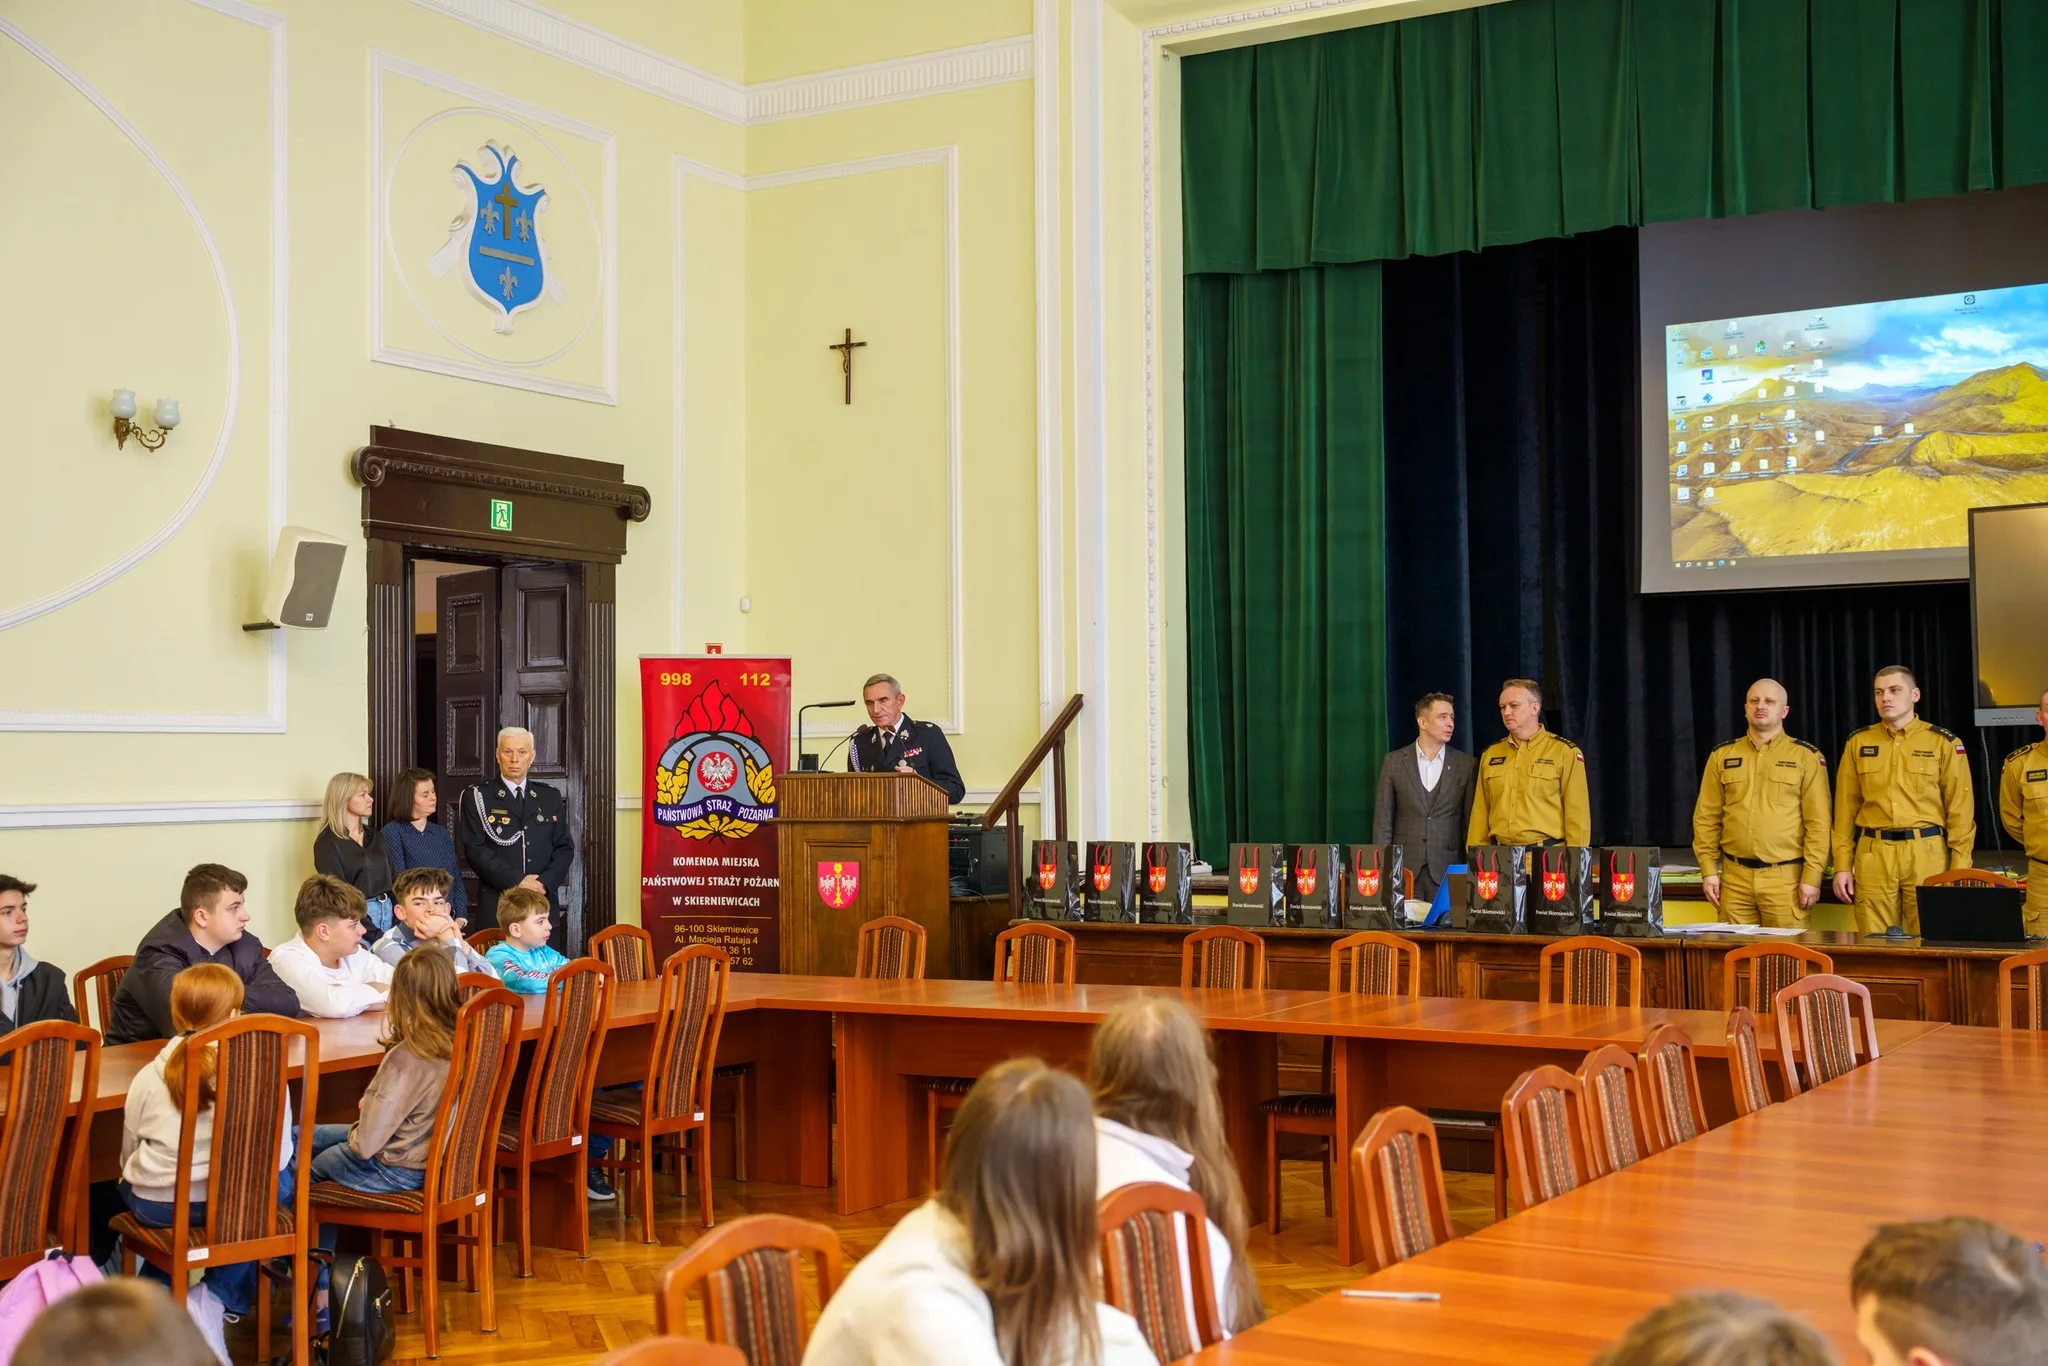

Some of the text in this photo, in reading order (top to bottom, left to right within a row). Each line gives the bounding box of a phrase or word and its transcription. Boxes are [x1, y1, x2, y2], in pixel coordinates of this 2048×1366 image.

[660, 673, 771, 686] 998 112
[657, 799, 774, 822] PAŃSTWOWA STRAŻ POŻARNA
[673, 857, 760, 867] KOMENDA MIEJSKA
[642, 875, 780, 888] PAŃSTWOWEJ STRAŻY POŻARN
[672, 896, 760, 907] W SKIERNIEWICACH
[674, 925, 759, 934] 96-100 Skierniewice
[674, 936, 686, 944] Al.
[688, 936, 722, 946] Macieja
[724, 936, 750, 946] Rataja
[729, 946, 740, 954] 36
[730, 957, 740, 965] 57
[742, 957, 753, 965] 62
